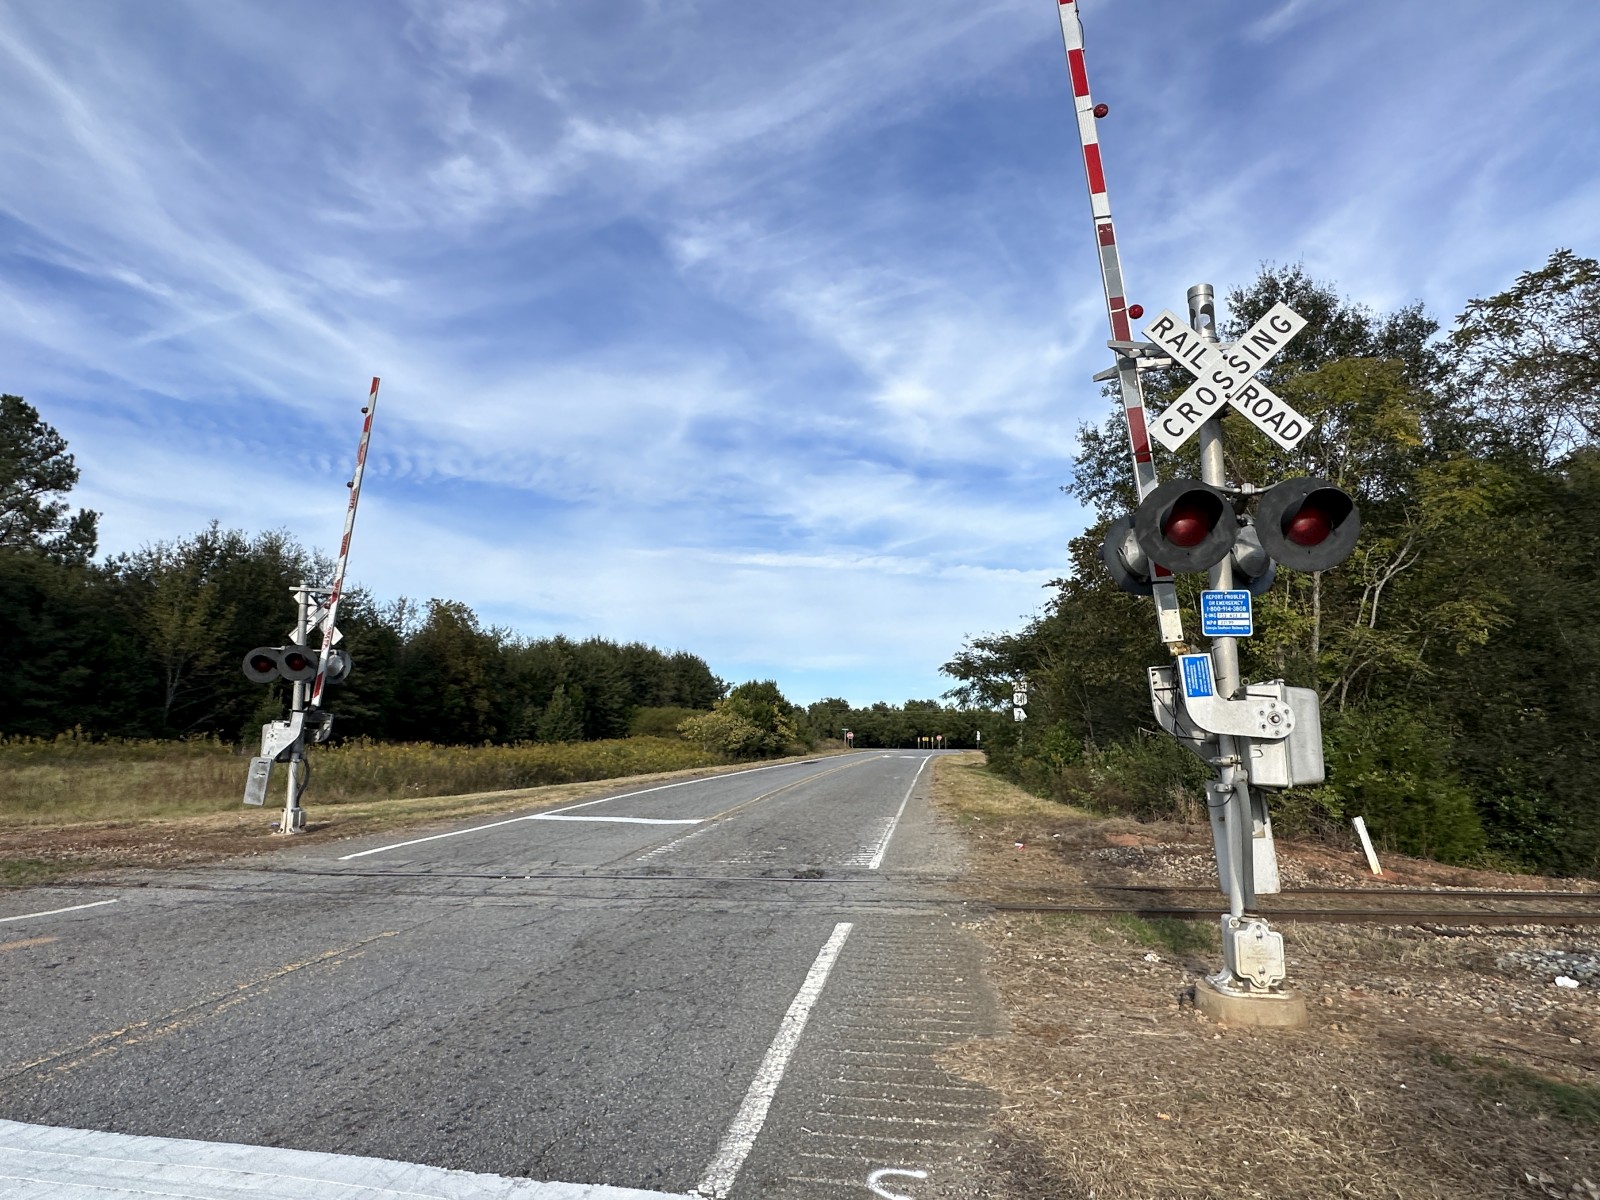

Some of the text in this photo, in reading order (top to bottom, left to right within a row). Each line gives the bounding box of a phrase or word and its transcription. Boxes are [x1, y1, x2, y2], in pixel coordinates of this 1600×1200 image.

[1151, 316, 1302, 441] RAIL ROAD
[1163, 315, 1292, 437] CROSSING
